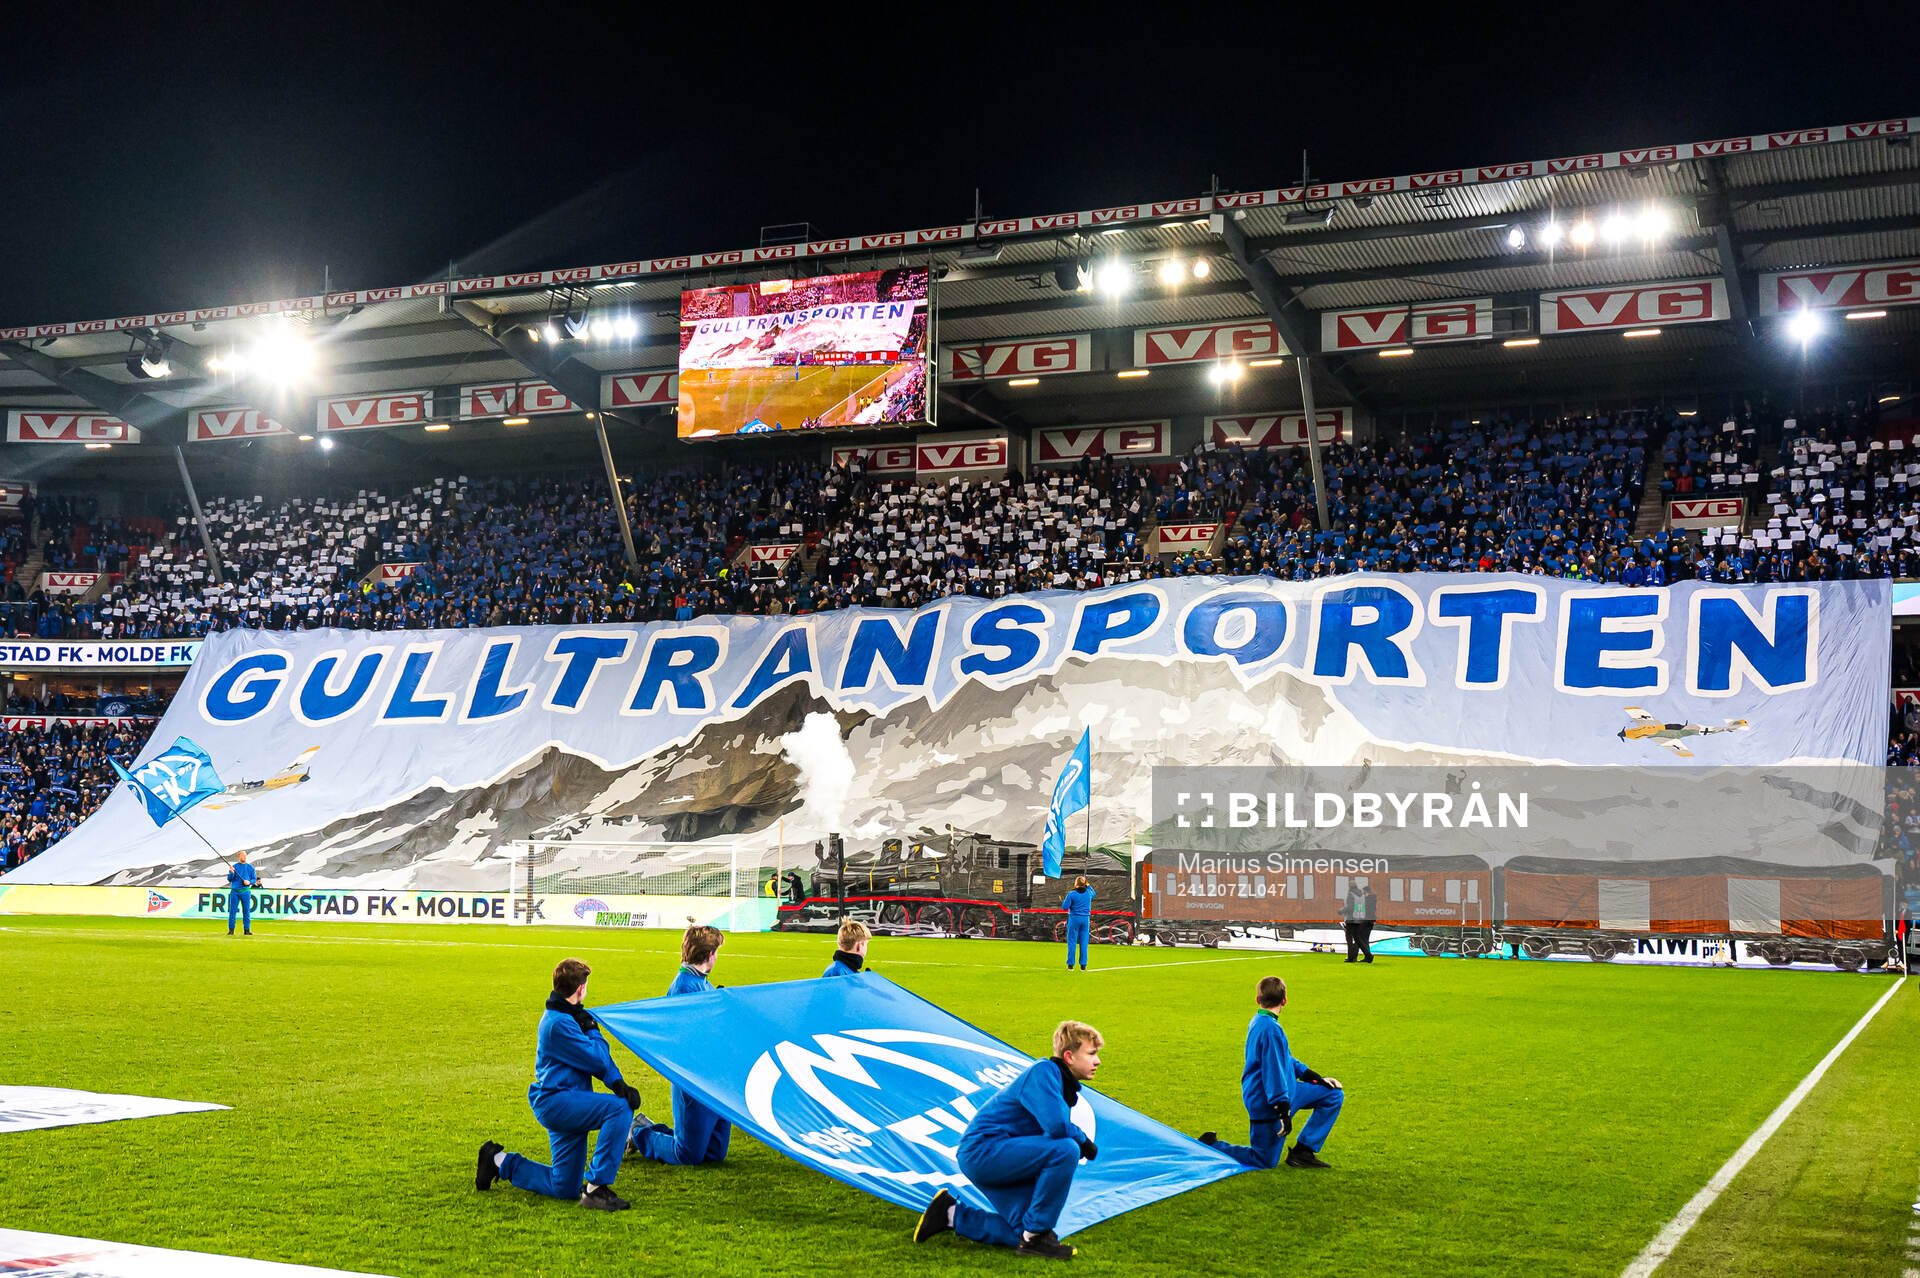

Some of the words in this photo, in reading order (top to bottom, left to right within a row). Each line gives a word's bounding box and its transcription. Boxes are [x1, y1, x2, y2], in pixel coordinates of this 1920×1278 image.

[0, 328, 27, 339] VG
[37, 325, 65, 335] VG
[76, 321, 105, 332] VG
[115, 317, 145, 328] VG
[155, 313, 186, 324] VG
[196, 310, 227, 320] VG
[237, 303, 268, 314] VG
[280, 299, 311, 309] VG
[327, 295, 356, 305] VG
[367, 289, 401, 300] VG
[412, 284, 447, 295] VG
[458, 279, 494, 290] VG
[505, 274, 542, 285] VG
[553, 269, 590, 281] VG
[602, 264, 639, 275] VG
[652, 259, 690, 270] VG
[702, 253, 742, 264] VG
[755, 247, 794, 259] VG
[809, 241, 849, 253] VG
[864, 235, 903, 247] VG
[919, 229, 959, 240] VG
[978, 222, 1017, 234] VG
[1035, 216, 1075, 228] VG
[1094, 208, 1137, 221] VG
[1152, 201, 1199, 214] VG
[1217, 194, 1263, 207] VG
[1280, 188, 1328, 200] VG
[1347, 180, 1392, 193] VG
[1413, 173, 1461, 186] VG
[1480, 165, 1530, 178] VG
[1550, 156, 1601, 170] VG
[1623, 148, 1675, 163] VG
[1696, 140, 1747, 155] VG
[1771, 130, 1824, 146] VG
[1852, 121, 1904, 136] VG
[1782, 266, 1920, 306] VG
[700, 303, 904, 335] GULLTRANSPORTEN
[1565, 287, 1703, 325] VG
[1342, 308, 1469, 343] VG
[1150, 324, 1271, 359] VG
[959, 341, 1070, 375] VG
[475, 385, 566, 413] VG
[616, 375, 678, 402] V
[202, 411, 282, 436] VG
[331, 396, 418, 425] VG
[24, 415, 123, 439] VG
[1045, 424, 1155, 457] VG
[1217, 413, 1336, 446] VG
[921, 444, 1000, 467] VG
[1675, 501, 1738, 517] VG
[1162, 526, 1214, 541] VG
[753, 547, 797, 560] VG
[52, 574, 95, 585] VG
[58, 646, 83, 662] FK
[98, 646, 165, 662] MOLDE
[170, 645, 192, 661] FK
[201, 580, 1814, 725] GULLTRANSPORTEN
[198, 893, 358, 915] FRRIKSTAD
[368, 896, 397, 916] FK
[417, 896, 504, 918] MOLDE
[514, 899, 545, 919] FK
[1638, 939, 1698, 956] KIWI
